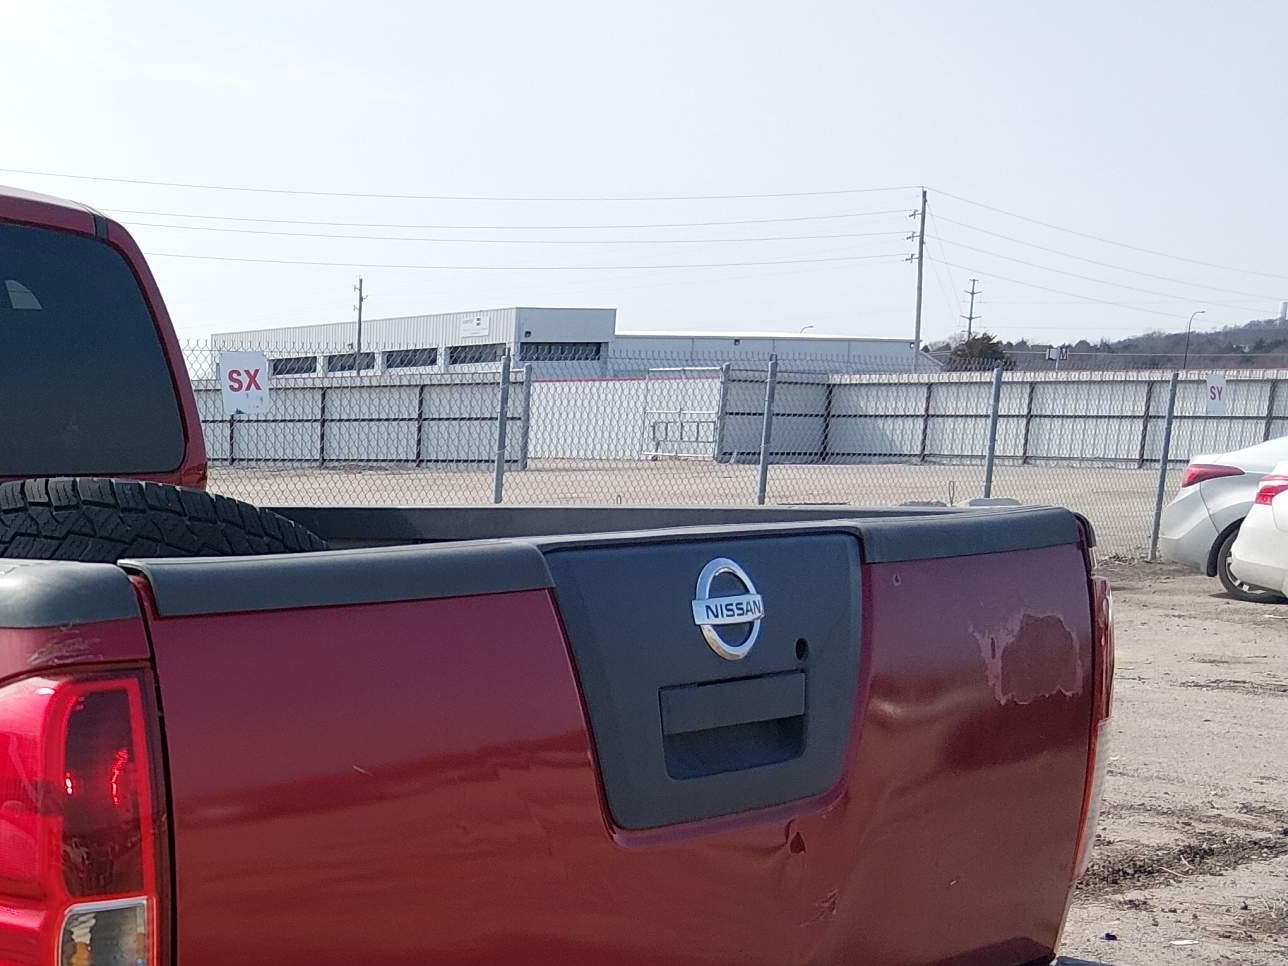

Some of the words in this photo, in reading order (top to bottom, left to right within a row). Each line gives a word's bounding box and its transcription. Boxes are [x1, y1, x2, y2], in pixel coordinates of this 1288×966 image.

[228, 368, 262, 392] SX
[1210, 385, 1223, 400] SY
[705, 600, 761, 619] NISSAN
